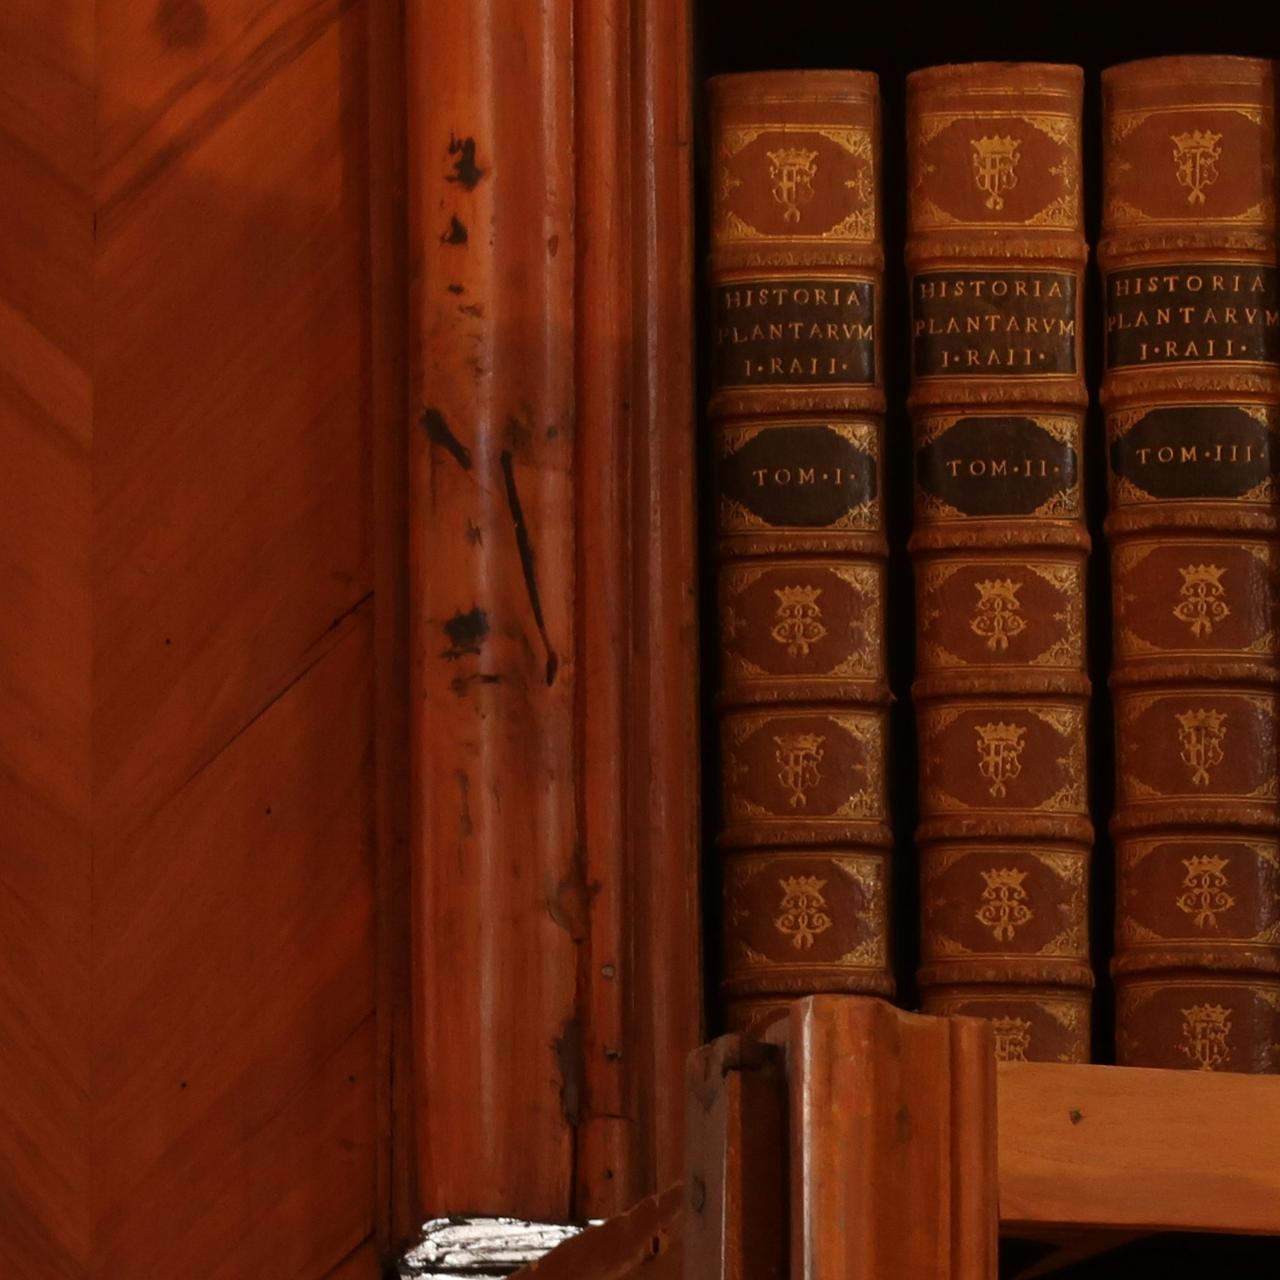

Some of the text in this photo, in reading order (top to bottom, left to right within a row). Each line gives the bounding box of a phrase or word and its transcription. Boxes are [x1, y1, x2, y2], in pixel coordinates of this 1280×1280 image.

[920, 279, 1064, 300] HISTORIA
[1114, 274, 1267, 297] HISTORIA
[724, 288, 862, 310] HISTORIA
[915, 314, 1076, 338] PLANTARVM
[1107, 307, 1280, 332] PLANTARVM
[718, 321, 873, 344] PLANTARVM
